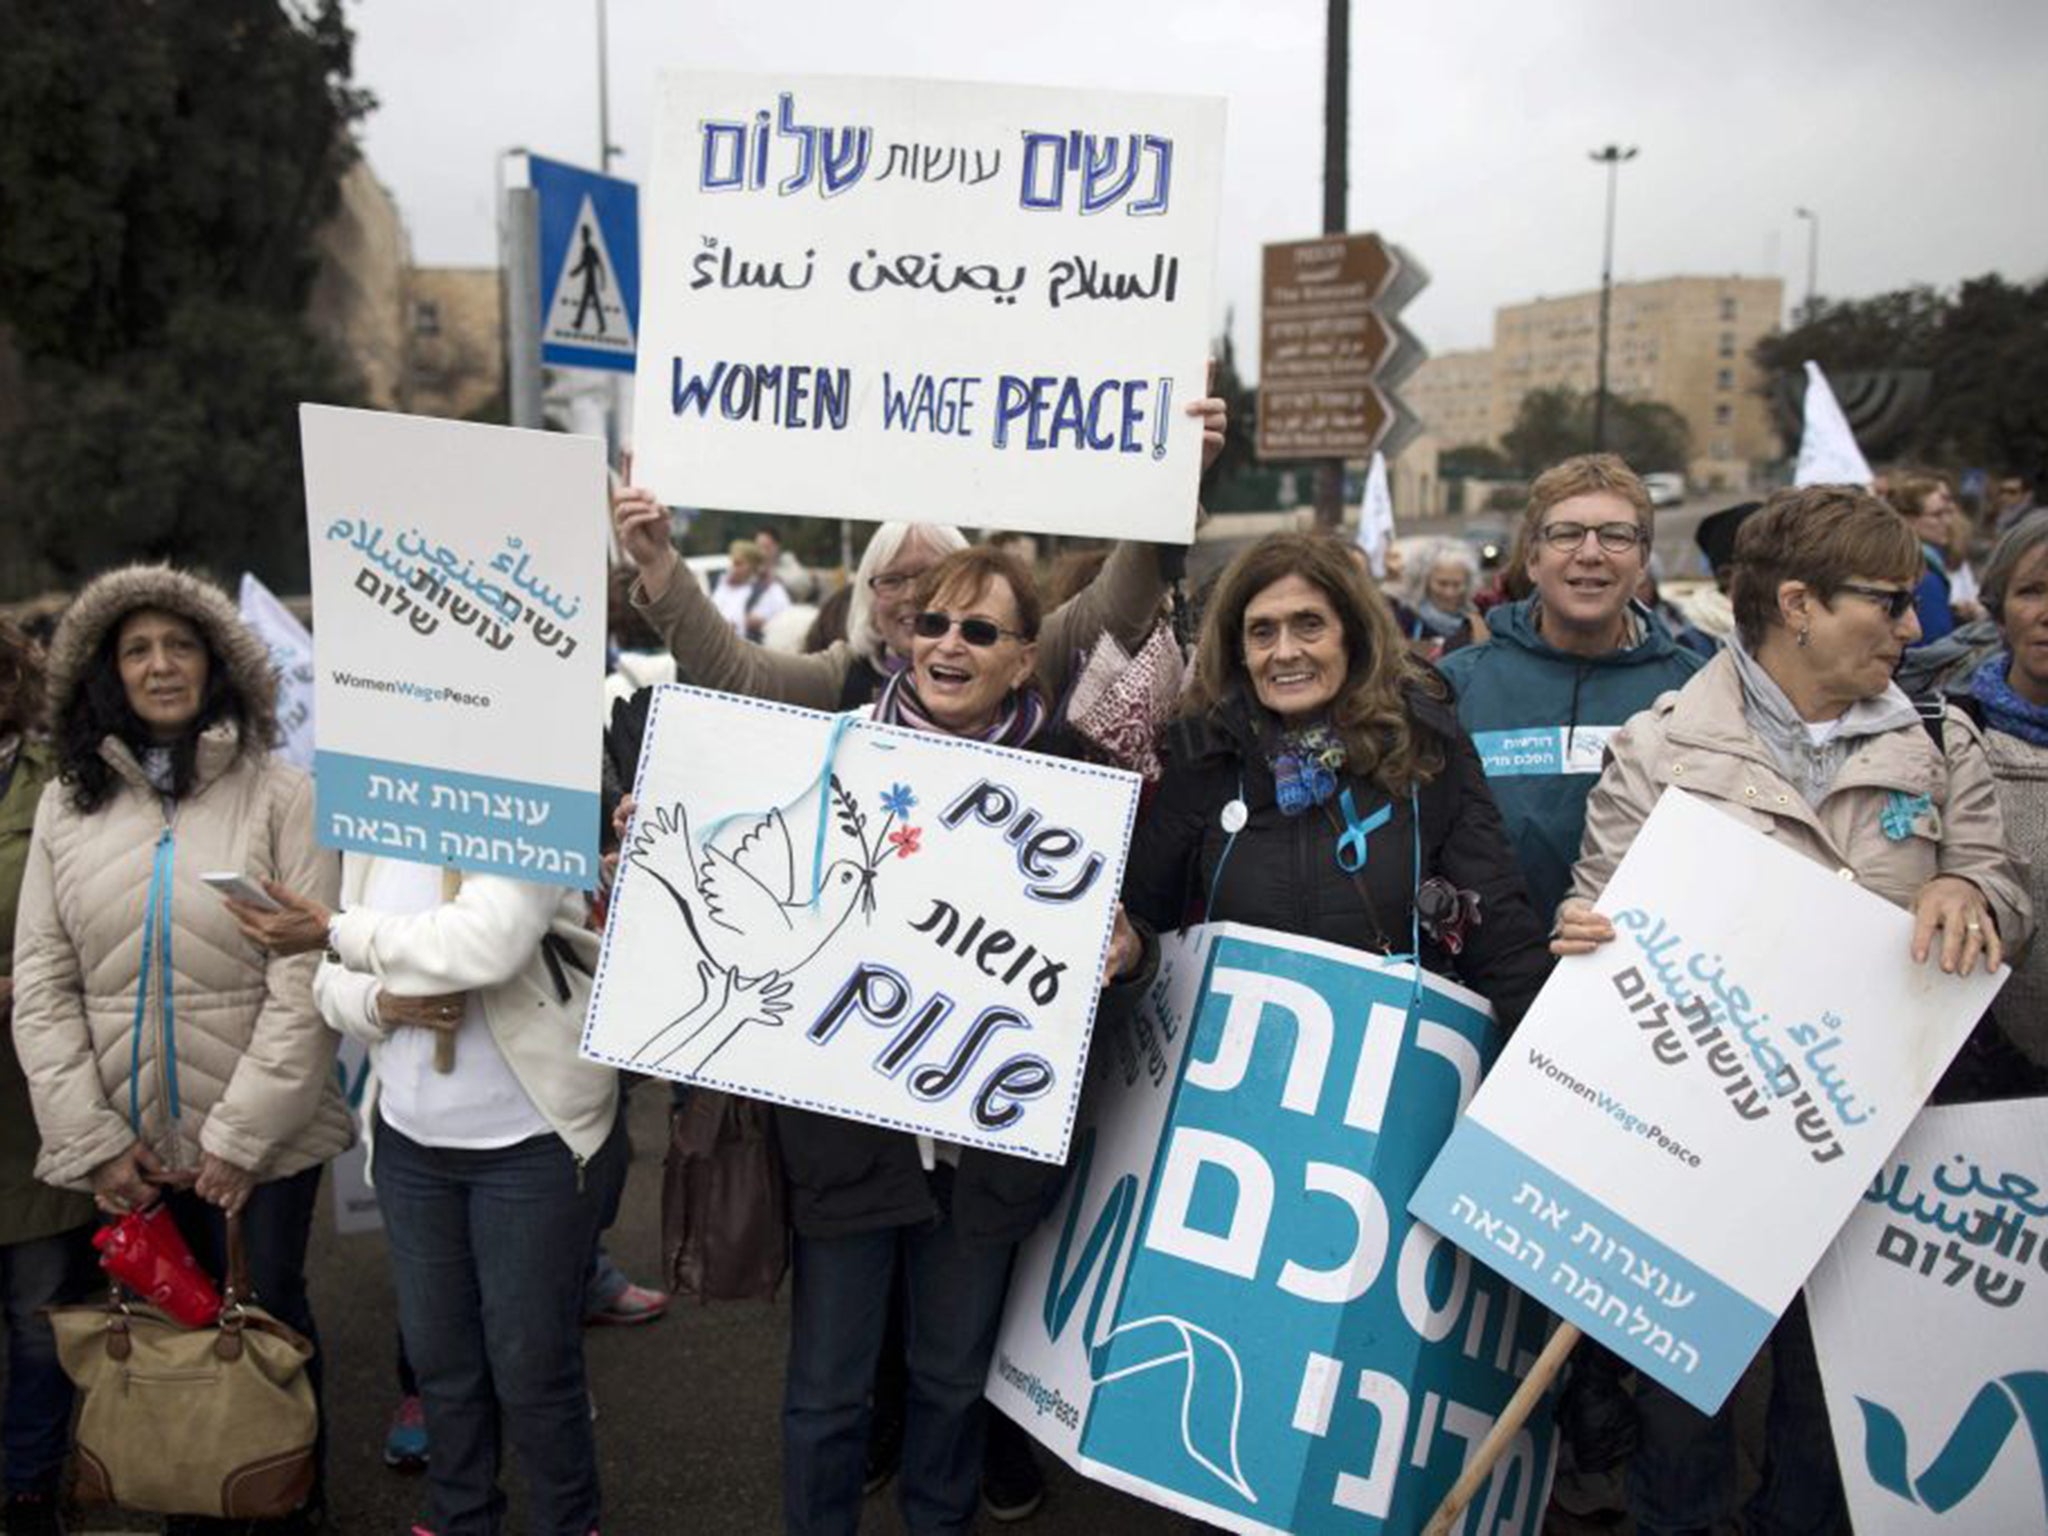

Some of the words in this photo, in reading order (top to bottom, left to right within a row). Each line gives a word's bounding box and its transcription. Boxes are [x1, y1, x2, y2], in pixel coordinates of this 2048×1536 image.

[699, 92, 873, 199] שלום
[874, 142, 1001, 186] עושות
[1019, 128, 1174, 216] נשים
[1048, 253, 1179, 307] السلام
[671, 356, 850, 430] WOMEN
[882, 370, 981, 436] WAGE
[993, 373, 1174, 460] PEACE!
[353, 566, 440, 637] שלום
[409, 567, 515, 651] עושות
[499, 590, 578, 660] נשים
[332, 670, 491, 708] WomenWagePeace
[332, 813, 427, 851] הבאה
[367, 774, 420, 805] את
[430, 784, 550, 826] עוצרות
[440, 830, 588, 877] המלחמה
[938, 777, 1107, 903] נשים
[907, 899, 1069, 1007] עושות
[807, 962, 1056, 1131] שלום
[1184, 966, 1483, 1135] רות
[1612, 965, 1688, 1066] שלום
[1676, 995, 1771, 1121] עושות
[1528, 1047, 1702, 1168] WomenWagePeace
[1775, 1062, 1845, 1163] נשים
[1451, 1194, 1546, 1272] הבאה
[1512, 1181, 1571, 1231] את
[1571, 1220, 1696, 1309] עוצרות
[1875, 1223, 2027, 1308] שלום
[1551, 1262, 1702, 1375] המלחמה
